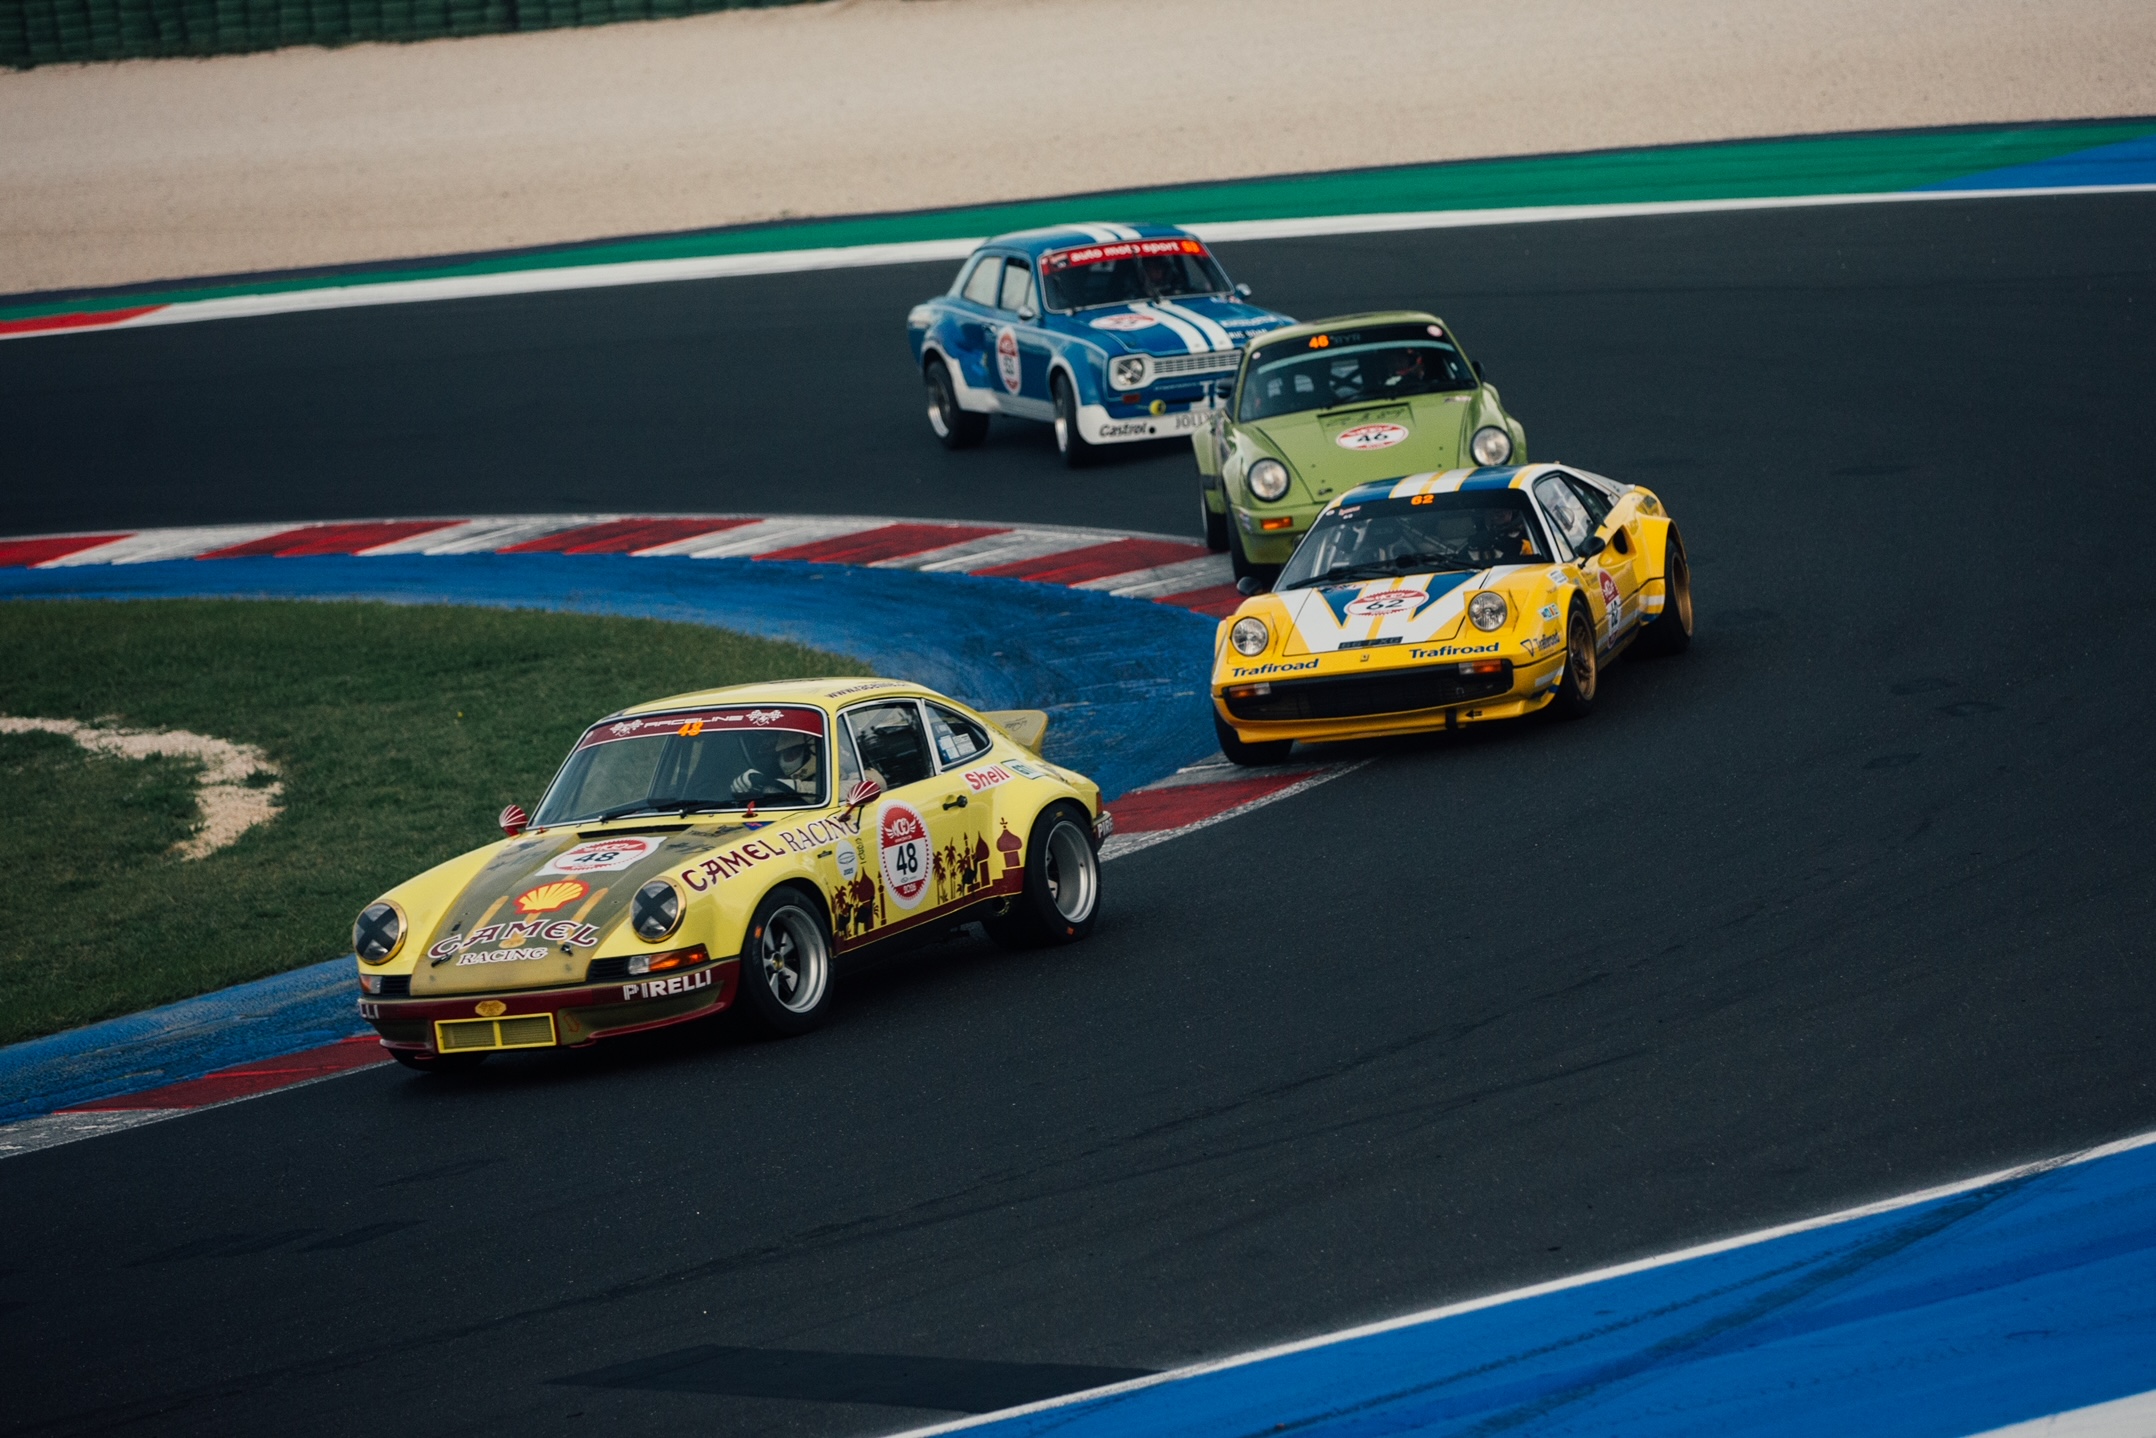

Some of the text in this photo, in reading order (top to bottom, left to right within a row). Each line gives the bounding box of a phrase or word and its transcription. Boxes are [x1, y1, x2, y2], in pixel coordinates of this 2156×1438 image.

[1070, 248, 1103, 263] auto
[1141, 241, 1180, 254] sport
[1100, 422, 1147, 437] Castrol
[1357, 432, 1389, 443] 46
[1411, 494, 1434, 506] 62
[1366, 599, 1404, 611] 62
[1409, 642, 1500, 659] Trafiroad
[1231, 658, 1319, 678] Trafiroad
[644, 715, 744, 728] RACELINE
[677, 721, 705, 737] 48
[965, 765, 1010, 791] Shell
[573, 851, 620, 863] 48
[681, 839, 786, 892] CAMEL
[779, 815, 860, 853] RACING
[896, 842, 918, 876] 48
[428, 918, 601, 959] CAMEL
[456, 947, 548, 967] RACING
[623, 969, 712, 1001] PIRELLI
